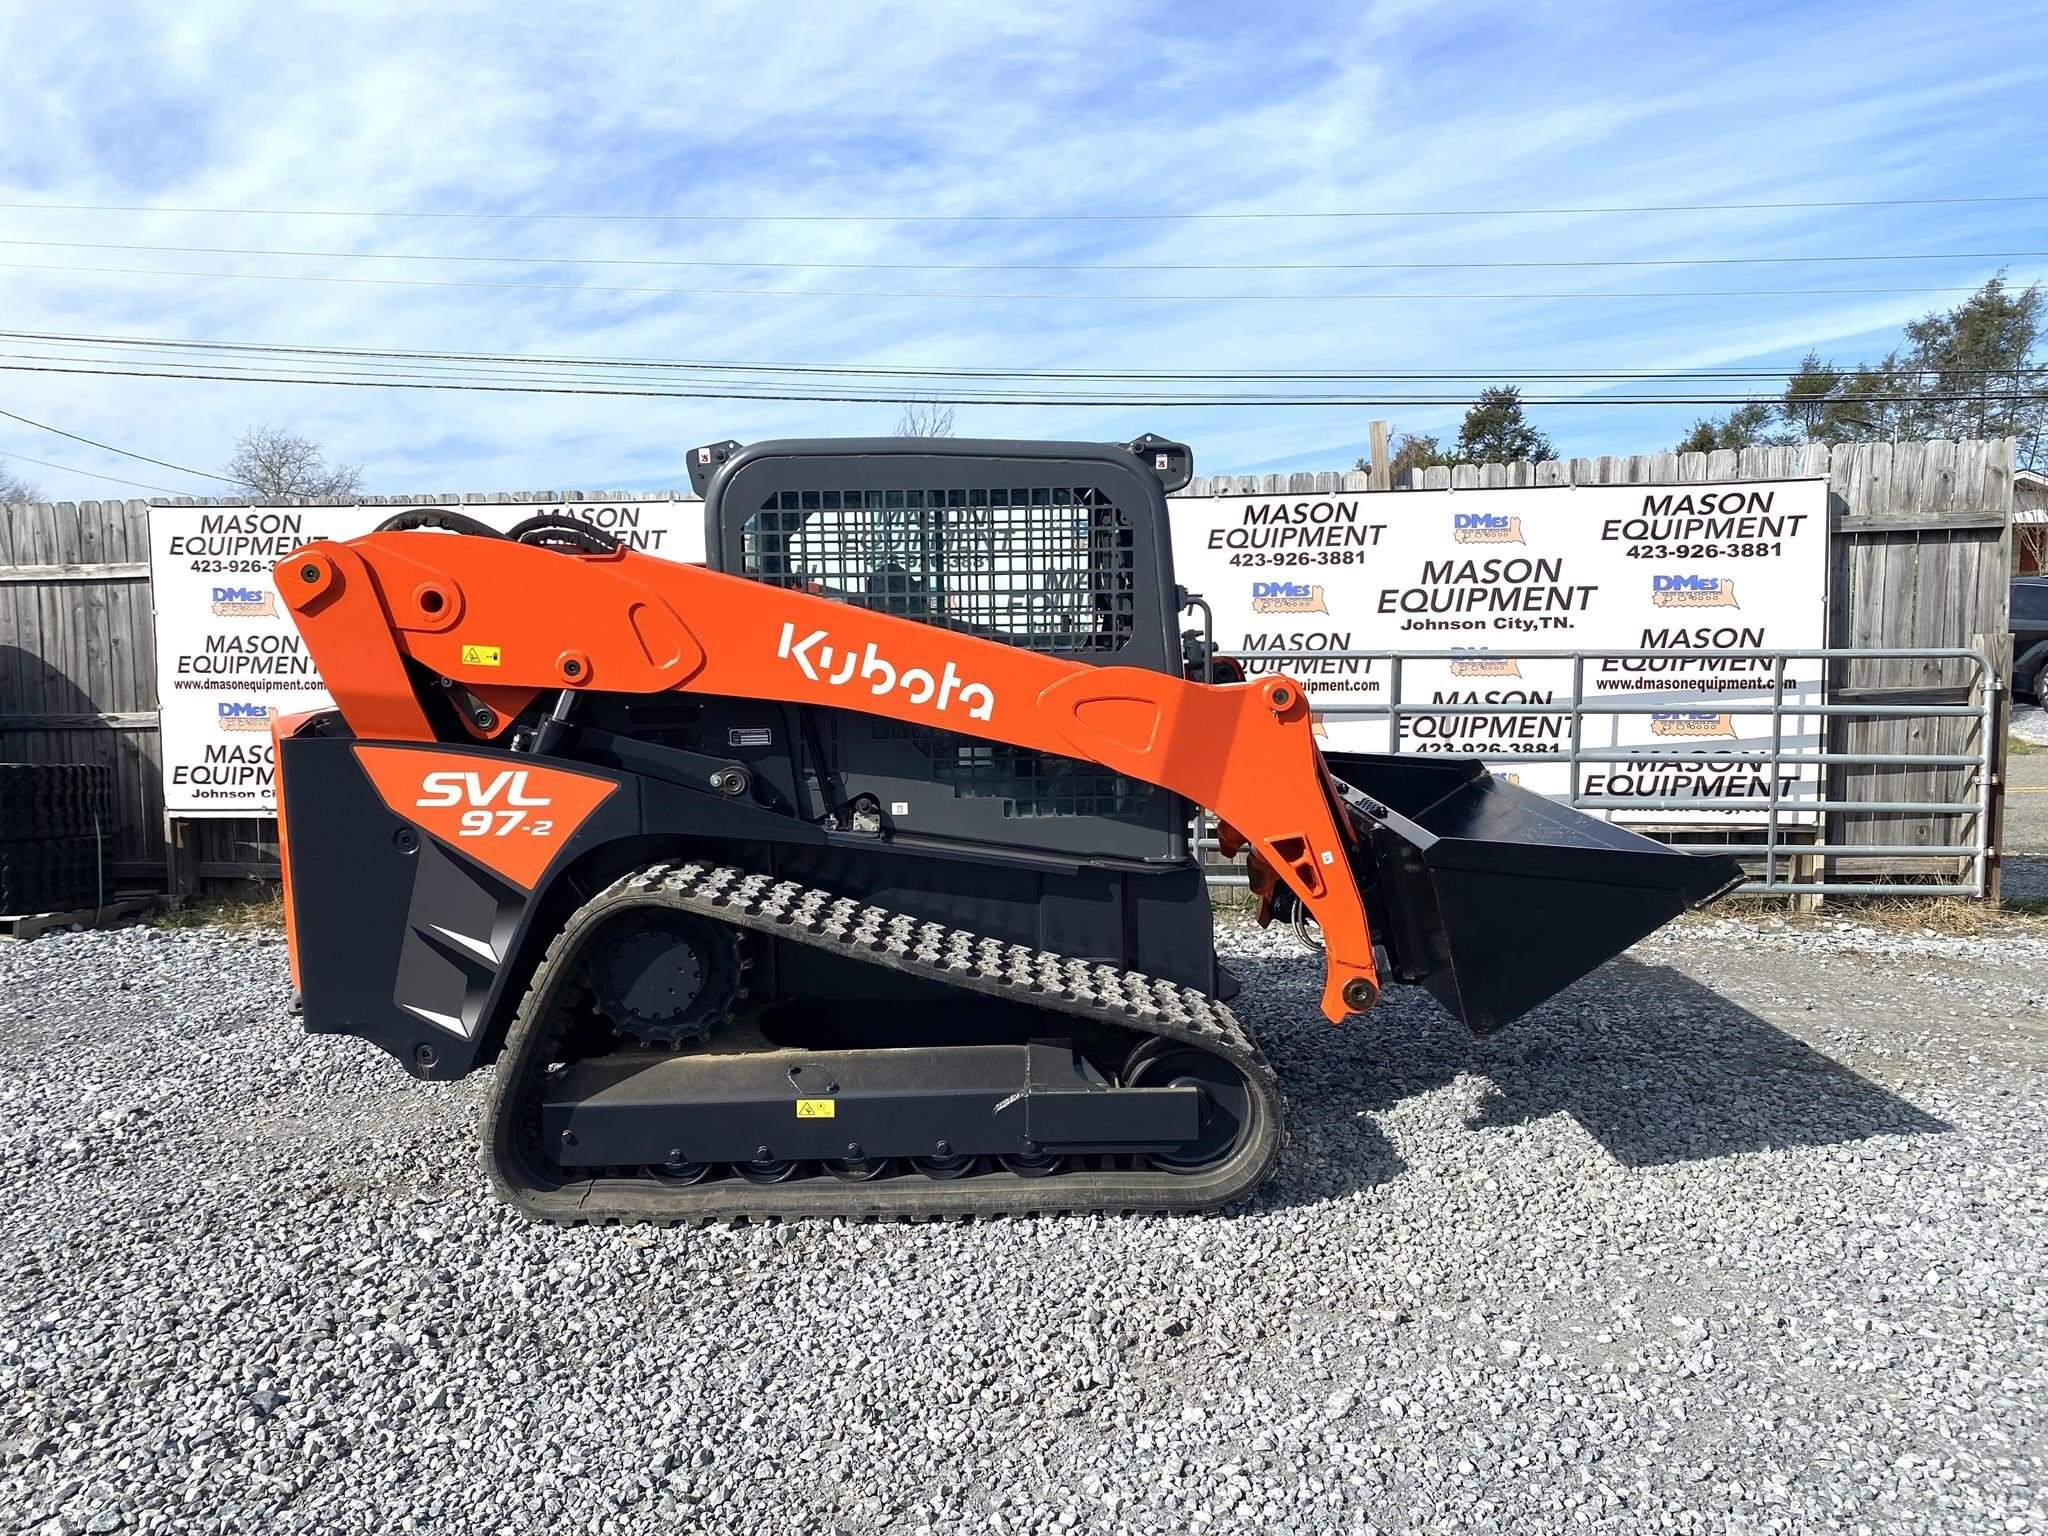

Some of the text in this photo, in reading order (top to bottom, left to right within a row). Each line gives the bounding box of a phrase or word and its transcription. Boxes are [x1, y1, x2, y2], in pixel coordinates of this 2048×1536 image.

[1243, 501, 1359, 526] MASON
[1642, 491, 1774, 517] MASON
[200, 514, 302, 534] MASON
[1601, 514, 1808, 541] EQUIPMENT
[1207, 524, 1387, 550] EQUIPMENT
[1229, 551, 1365, 567] 423-926-3881
[1626, 542, 1781, 559] 423-926-3881
[1421, 557, 1563, 585] MASON
[1377, 585, 1599, 614] EQUIPMENT
[1400, 616, 1575, 632] Johnson City,TN.
[205, 635, 299, 654] MASON
[1242, 632, 1351, 651] MASON
[1640, 627, 1765, 649] MASON
[777, 621, 995, 722] Kubota
[174, 678, 327, 693] www.dmasonequipment.com
[1596, 676, 1797, 693] www.dmasonequipment.cm
[1432, 690, 1553, 705] MASON
[172, 766, 275, 785] EQUIPM
[1584, 775, 1801, 797] EQUIPMENT
[191, 789, 256, 799] Johnson
[416, 771, 552, 807] SVL
[459, 810, 553, 836] 97-2
